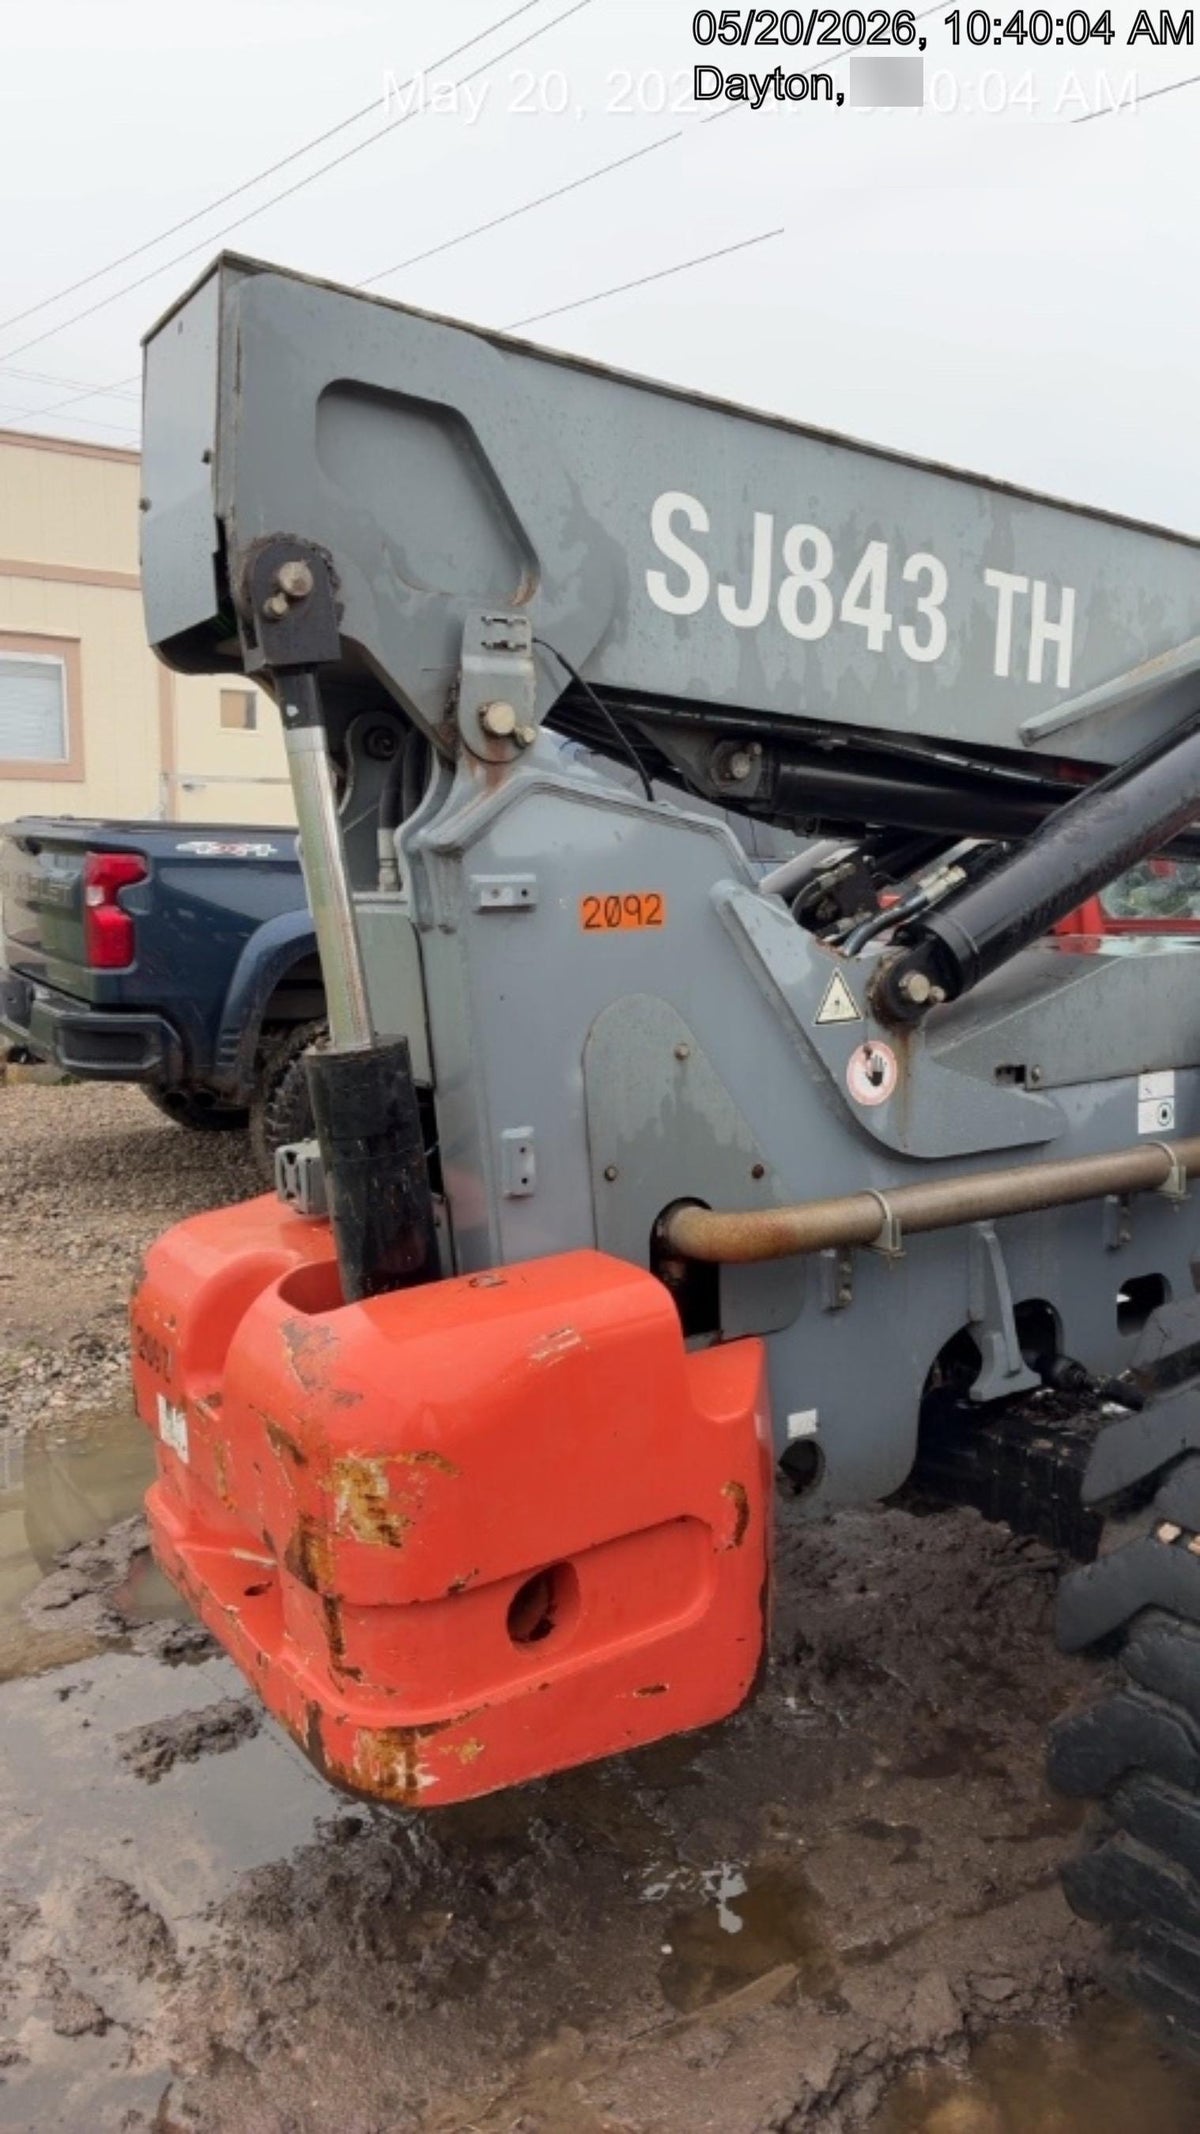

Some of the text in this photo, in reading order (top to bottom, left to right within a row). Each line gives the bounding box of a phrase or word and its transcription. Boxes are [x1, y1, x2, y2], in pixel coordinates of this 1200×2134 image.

[645, 491, 1076, 689] SJ843 TH
[582, 892, 663, 930] 2092
